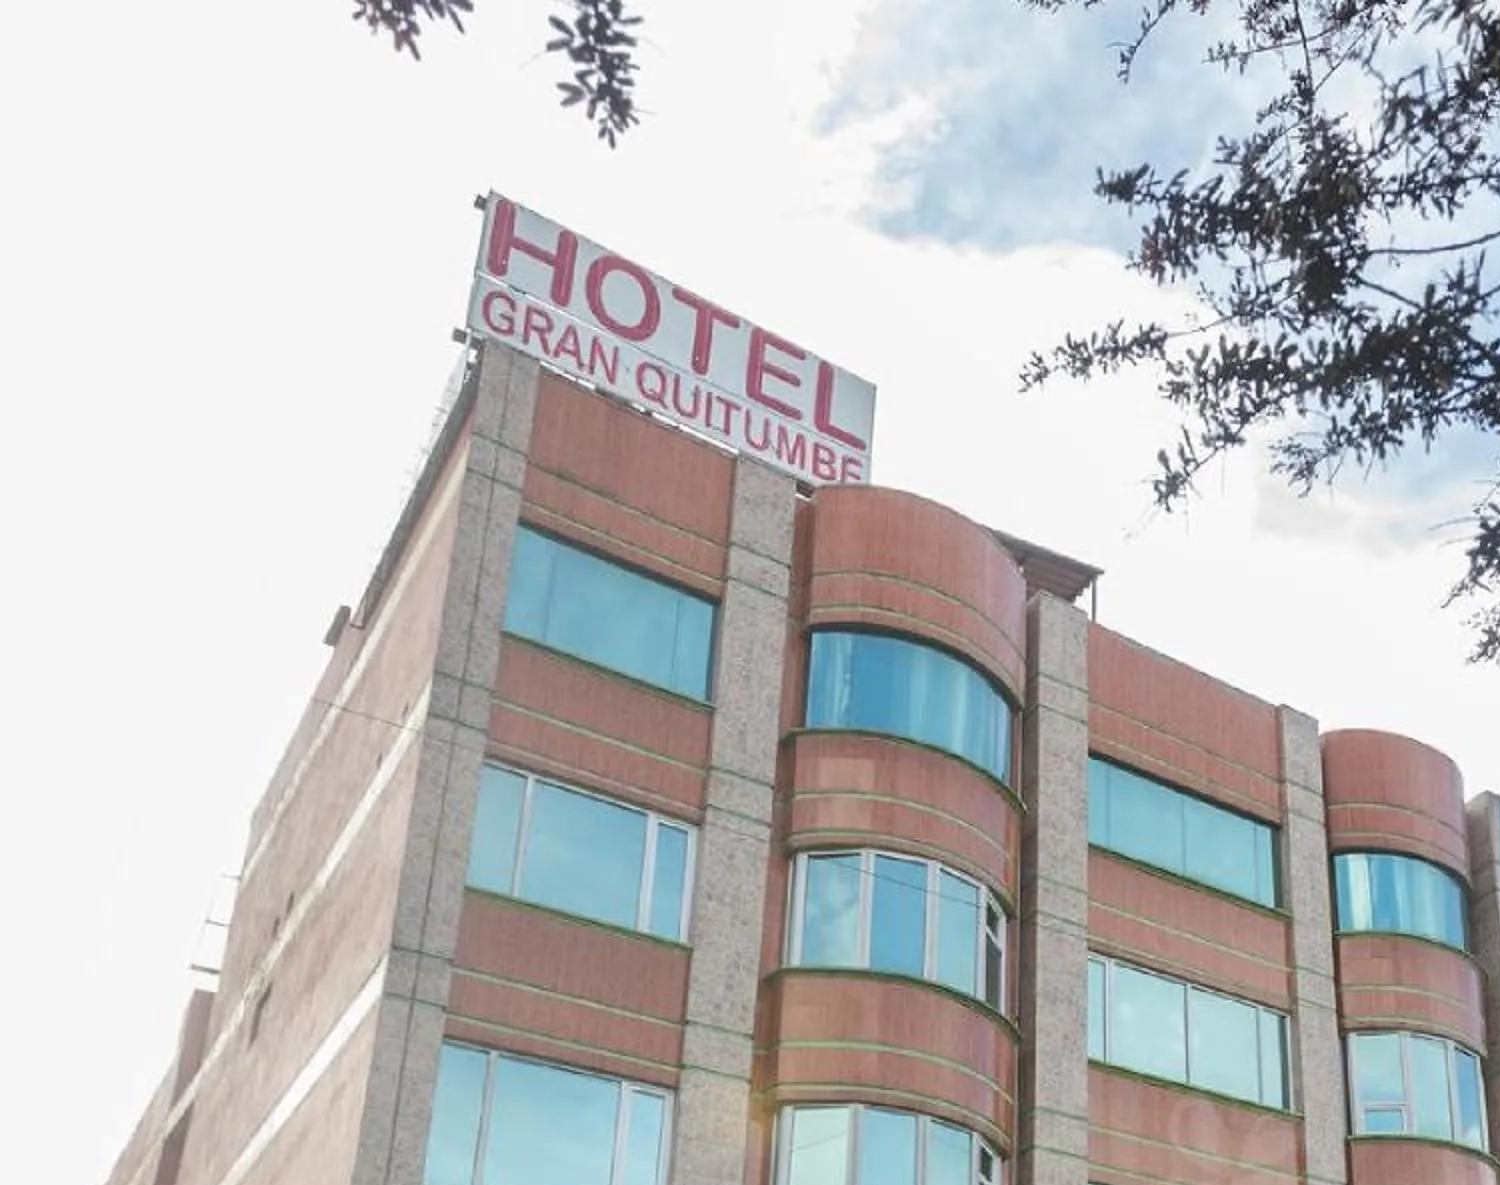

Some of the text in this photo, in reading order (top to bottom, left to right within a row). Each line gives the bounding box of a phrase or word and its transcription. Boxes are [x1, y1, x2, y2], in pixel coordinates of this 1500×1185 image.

[481, 290, 865, 482] GRAN QUITUMBE
[486, 199, 867, 452] HOTEL
